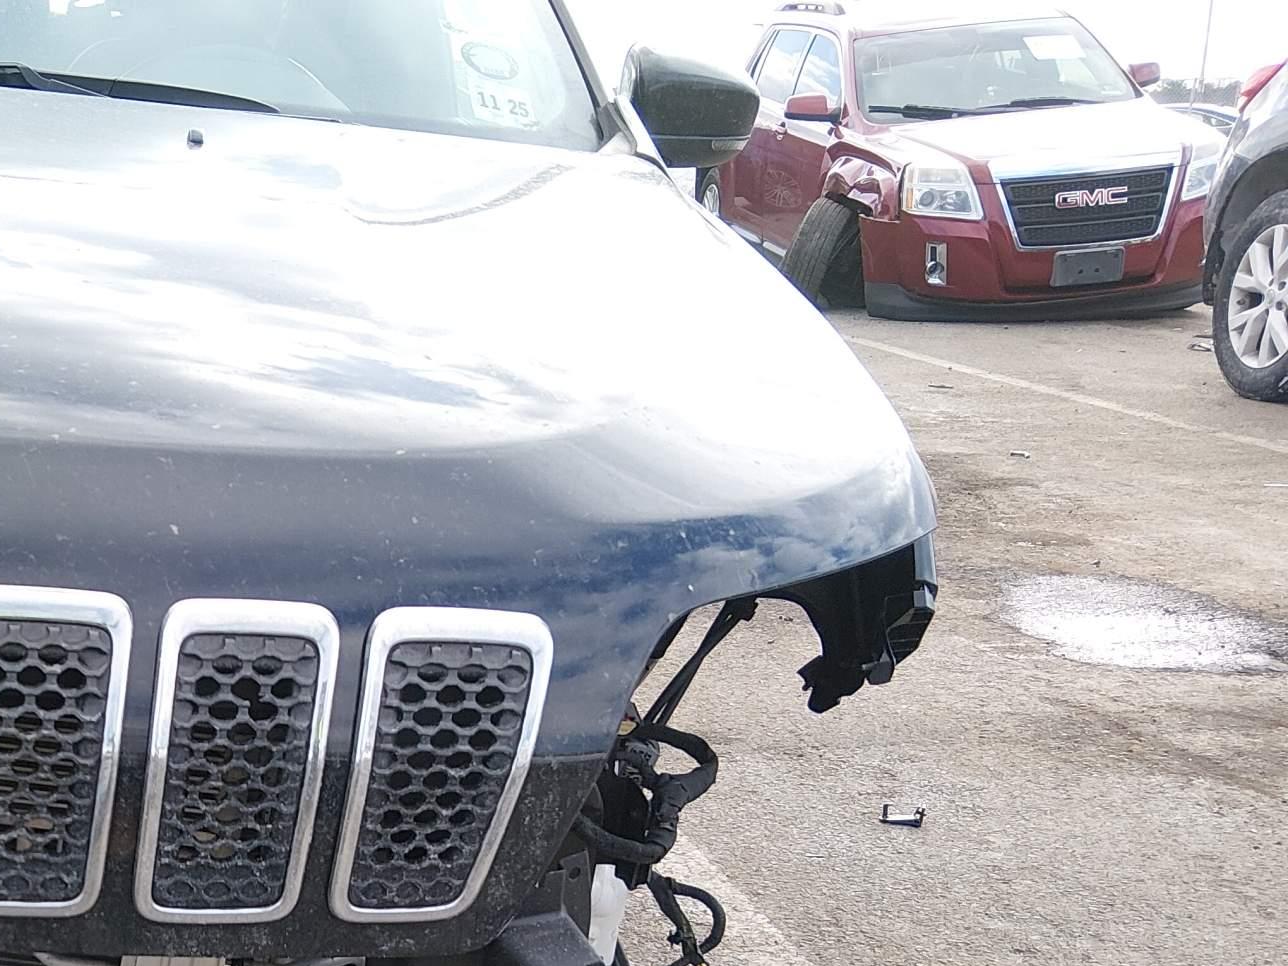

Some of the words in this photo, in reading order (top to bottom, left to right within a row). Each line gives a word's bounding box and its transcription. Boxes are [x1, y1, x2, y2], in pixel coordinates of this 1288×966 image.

[477, 91, 501, 111] 11
[507, 99, 530, 118] 25
[1054, 185, 1128, 209] GMC
